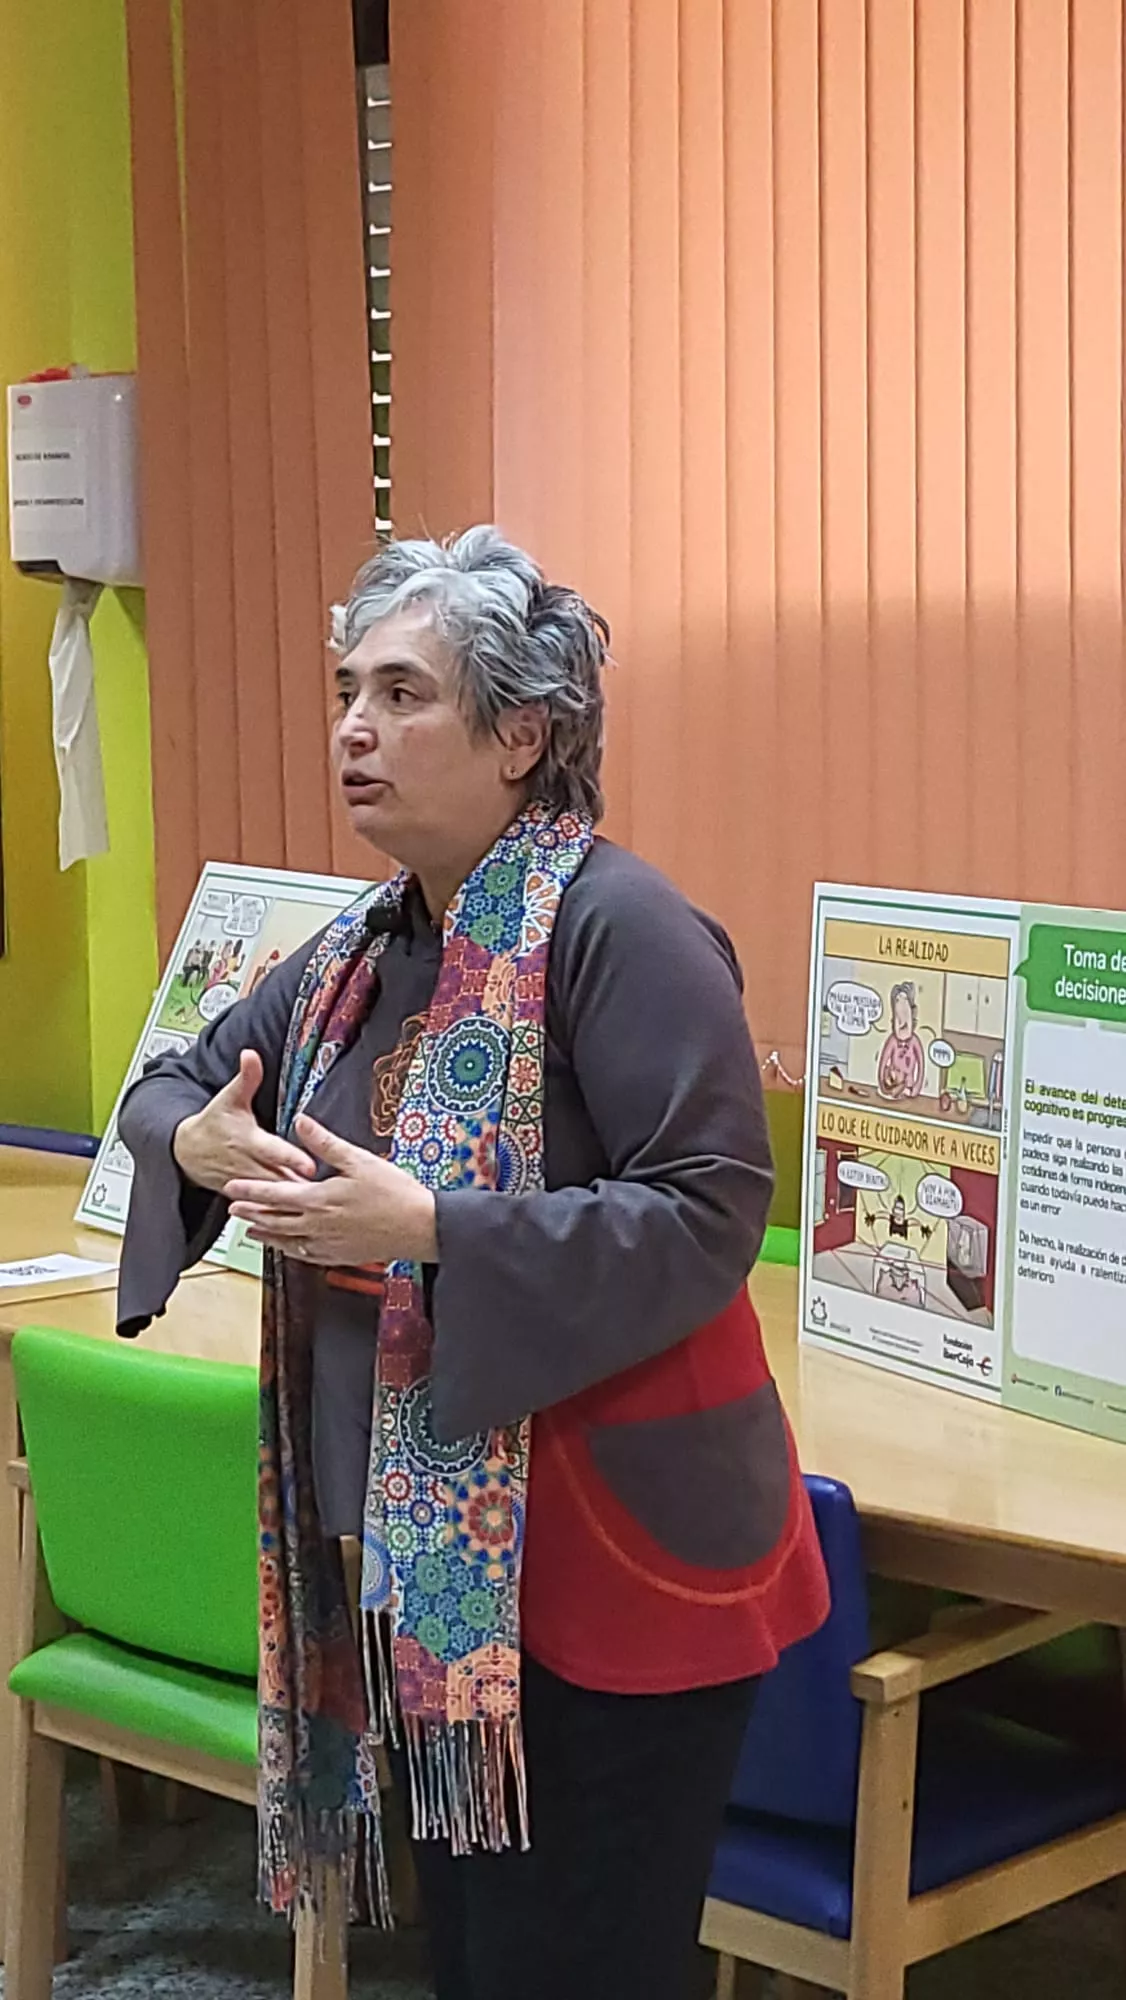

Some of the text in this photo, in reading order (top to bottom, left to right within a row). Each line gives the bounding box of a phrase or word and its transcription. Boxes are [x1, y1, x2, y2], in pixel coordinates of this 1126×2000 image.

[879, 935, 949, 962] LA REALIDAD
[1063, 943, 1107, 970] Toma
[1025, 1078, 1035, 1094] El
[1039, 1085, 1076, 1101] avance
[1081, 1089, 1098, 1105] del
[1024, 1100, 1070, 1116] cognitivo
[1072, 1108, 1084, 1121] es
[821, 1112, 996, 1166] LO QUE EL CUIDADOR VE A VECES
[1023, 1128, 1122, 1159] Impedir que la persona
[1021, 1181, 1050, 1197] cuando
[1059, 1170, 1069, 1183] de
[1041, 1202, 1062, 1216] error
[1019, 1229, 1030, 1244] De
[1109, 1251, 1121, 1265] de
[1019, 1248, 1046, 1265] tareas
[1049, 1256, 1077, 1273] ayuda
